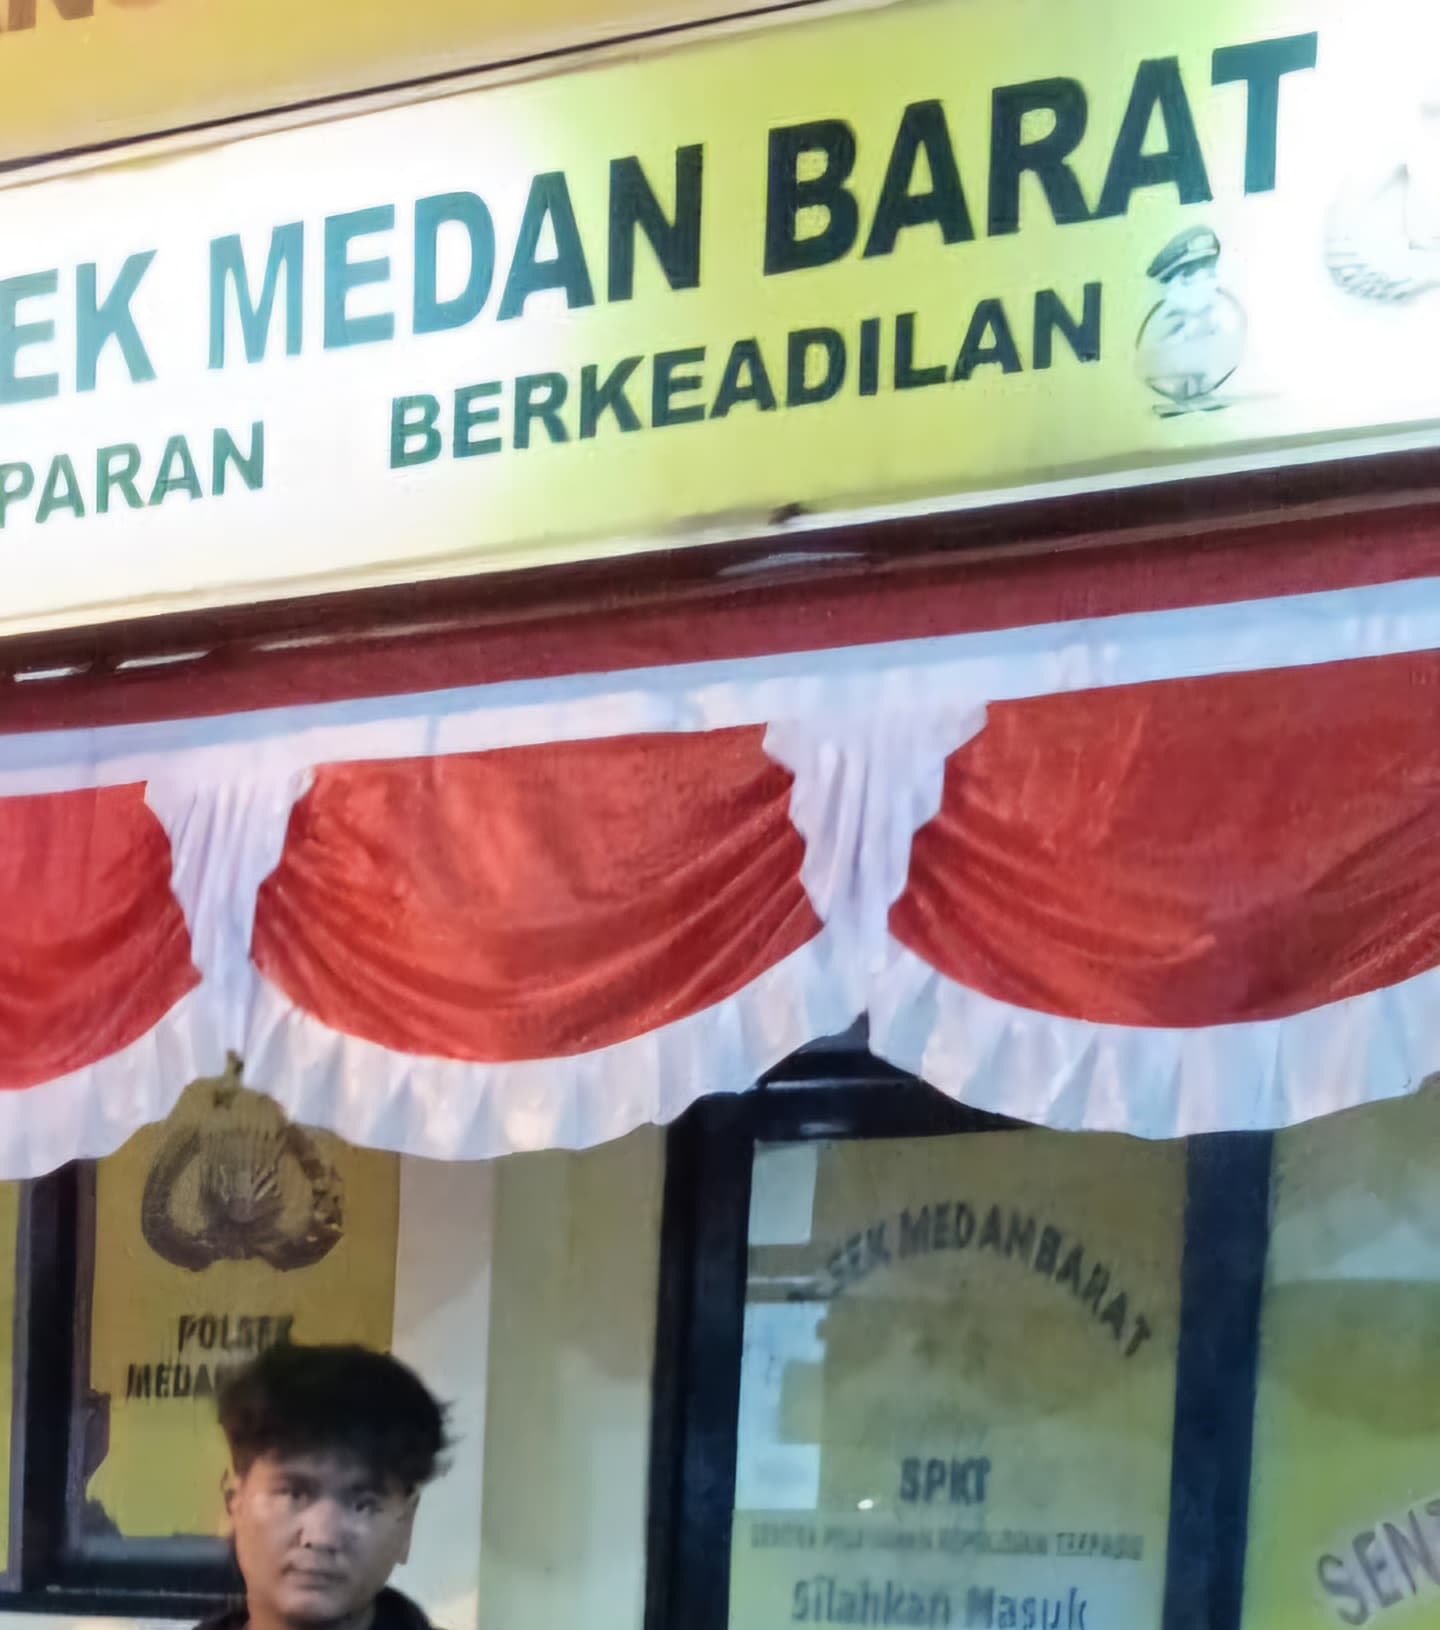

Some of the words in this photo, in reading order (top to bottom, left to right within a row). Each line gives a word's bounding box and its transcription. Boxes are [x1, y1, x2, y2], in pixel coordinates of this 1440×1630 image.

[208, 144, 705, 370] MEDAN
[763, 32, 1318, 276] BARAT
[389, 282, 1103, 469] BERKEADILAN
[1316, 1499, 1440, 1626] SEN
